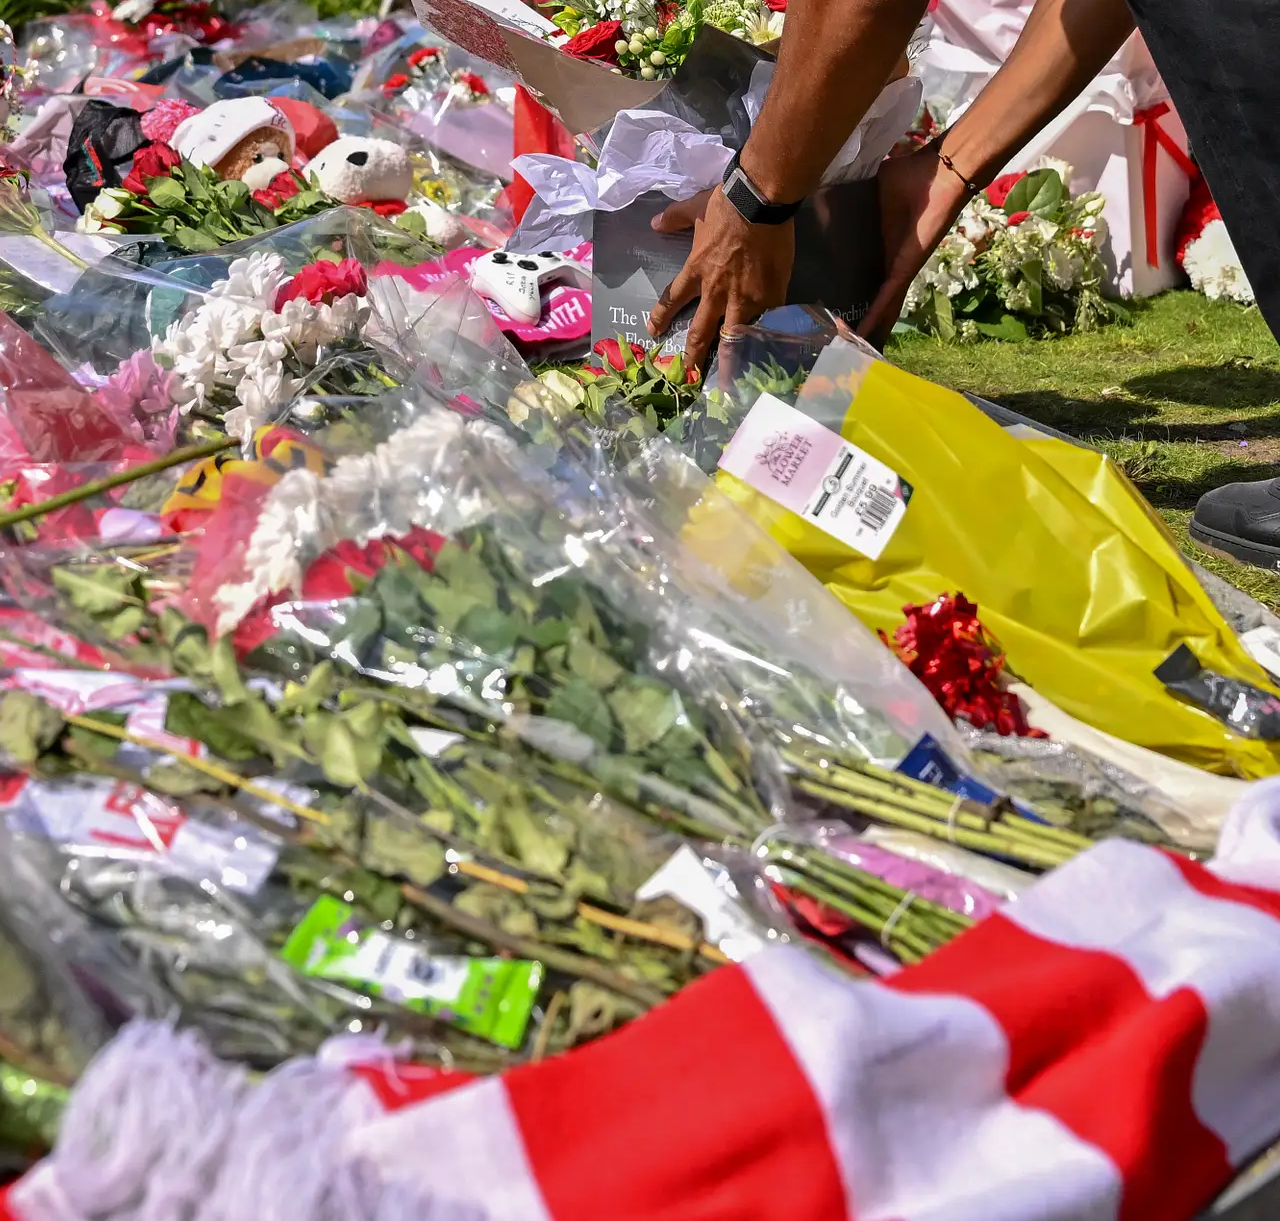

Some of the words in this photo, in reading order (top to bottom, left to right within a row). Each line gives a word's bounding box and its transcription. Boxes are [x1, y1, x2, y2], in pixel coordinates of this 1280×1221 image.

[540, 296, 586, 334] WITH
[609, 305, 638, 326] The
[771, 433, 805, 481] FLOWER
[782, 438, 813, 487] MARKET
